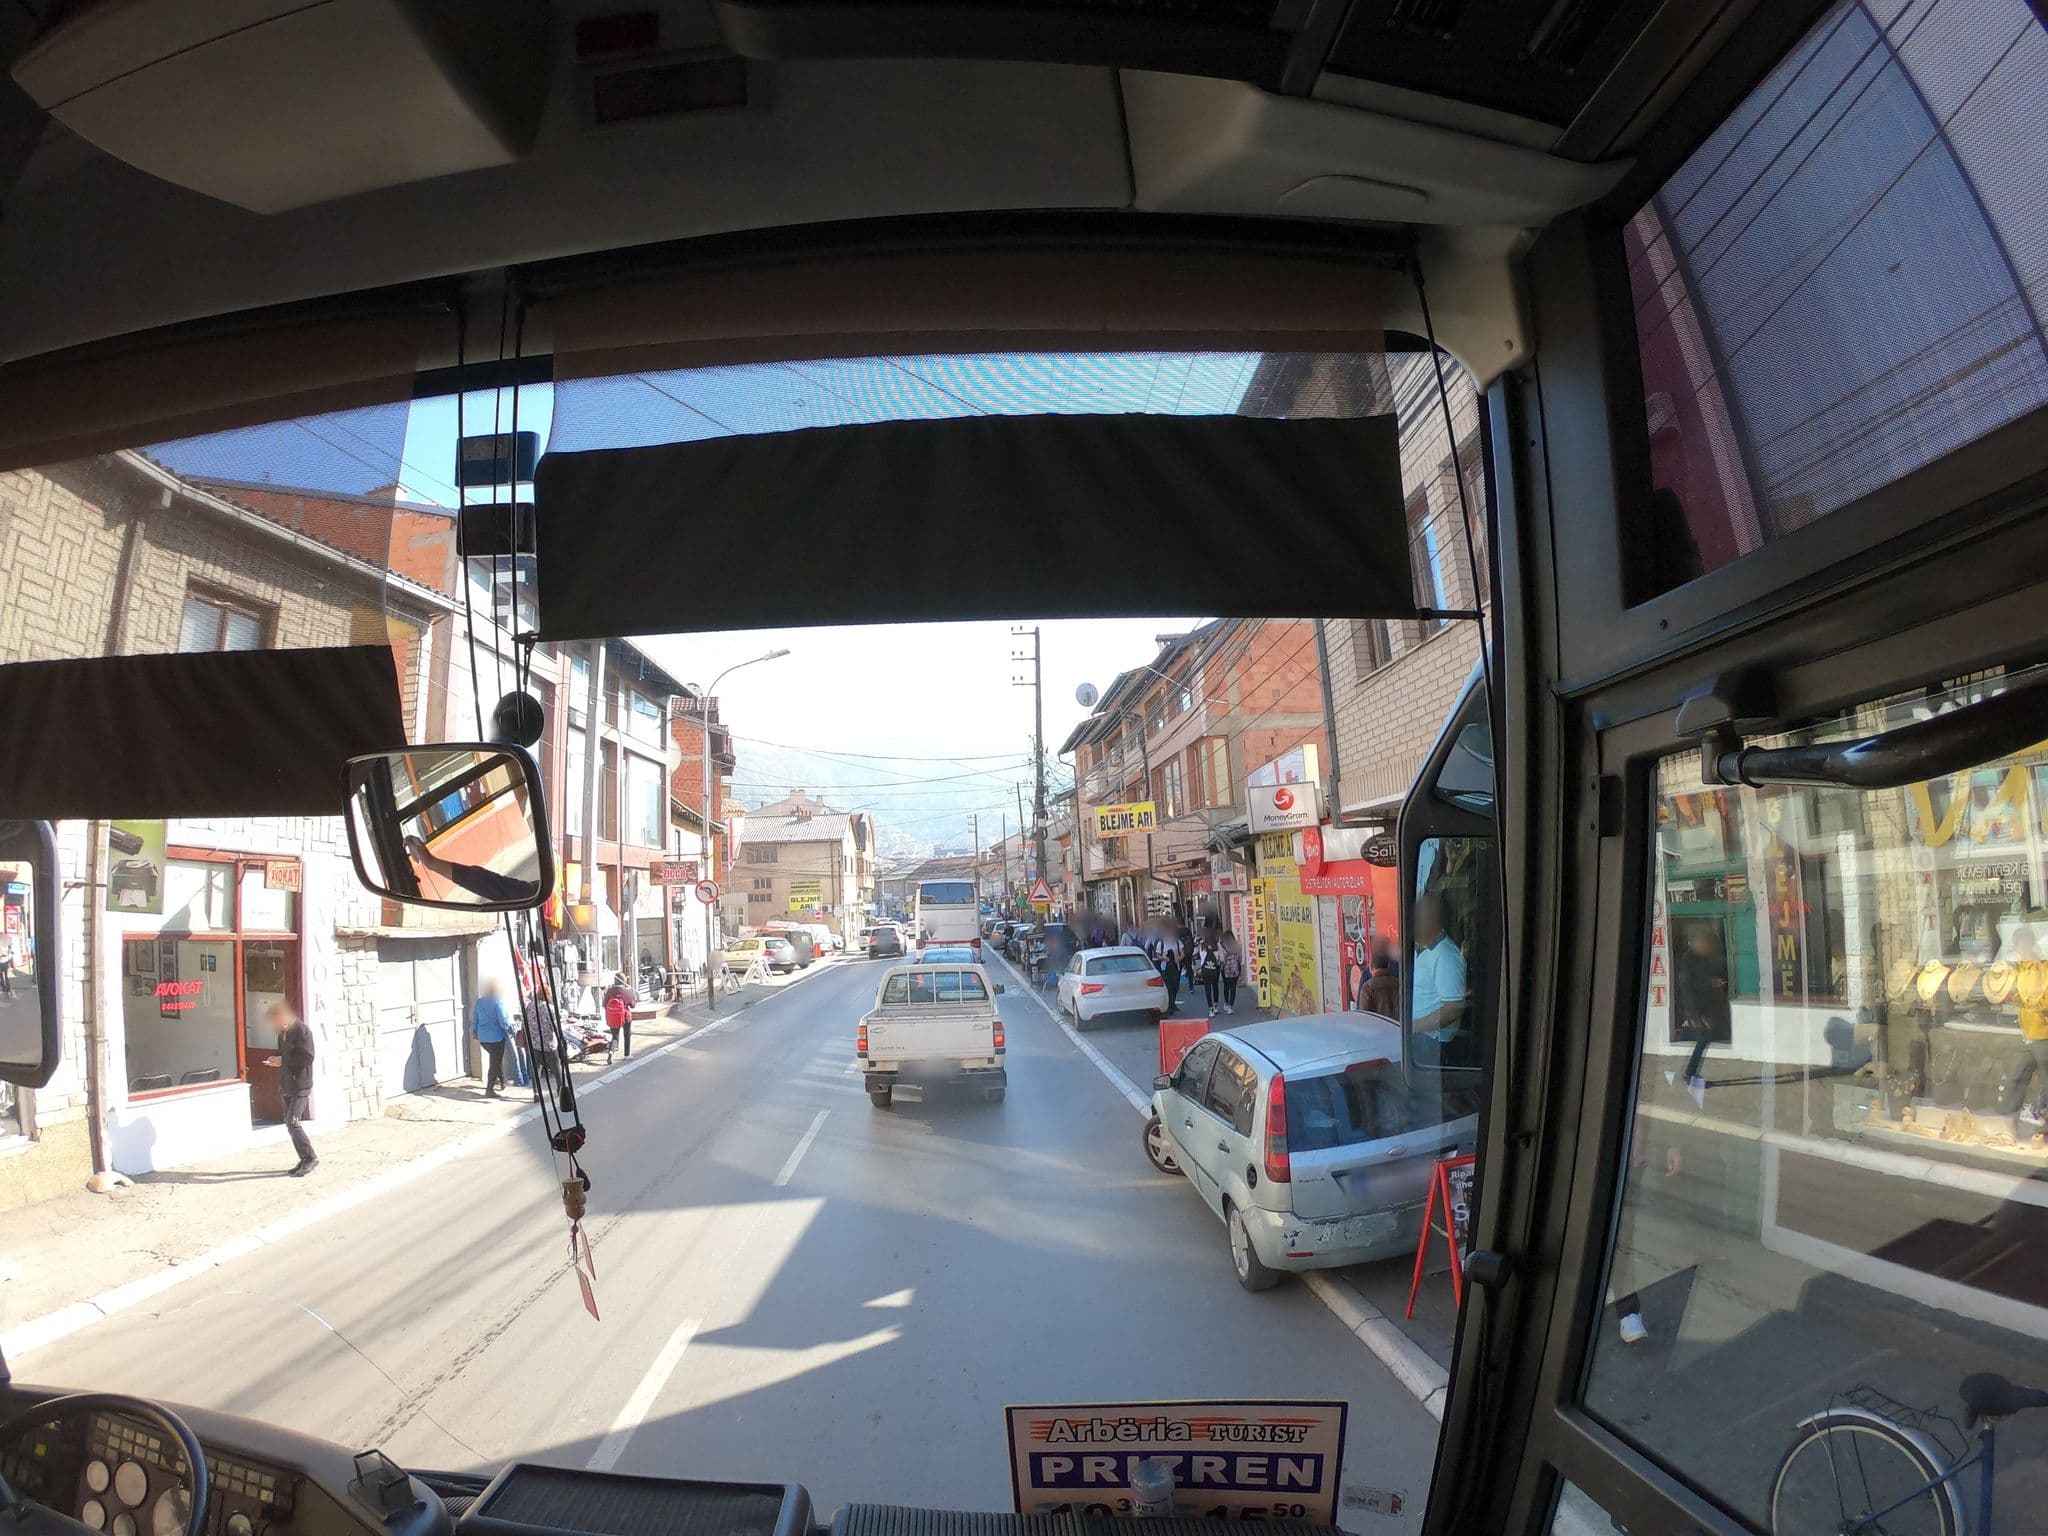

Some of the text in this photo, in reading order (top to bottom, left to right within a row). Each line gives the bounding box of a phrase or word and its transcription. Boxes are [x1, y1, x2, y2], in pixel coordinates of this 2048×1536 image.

[1138, 811, 1152, 827] ARI
[1264, 812, 1308, 823] MoneyGram
[663, 869, 687, 878] ZICCO
[1301, 906, 1313, 924] ARI
[155, 981, 204, 996] AVOKAT
[1258, 966, 1268, 1000] ARI
[1046, 1416, 1307, 1443] Arbëria TURIST
[1041, 1455, 1314, 1487] PRIZREN
[1272, 1503, 1306, 1518] 50
